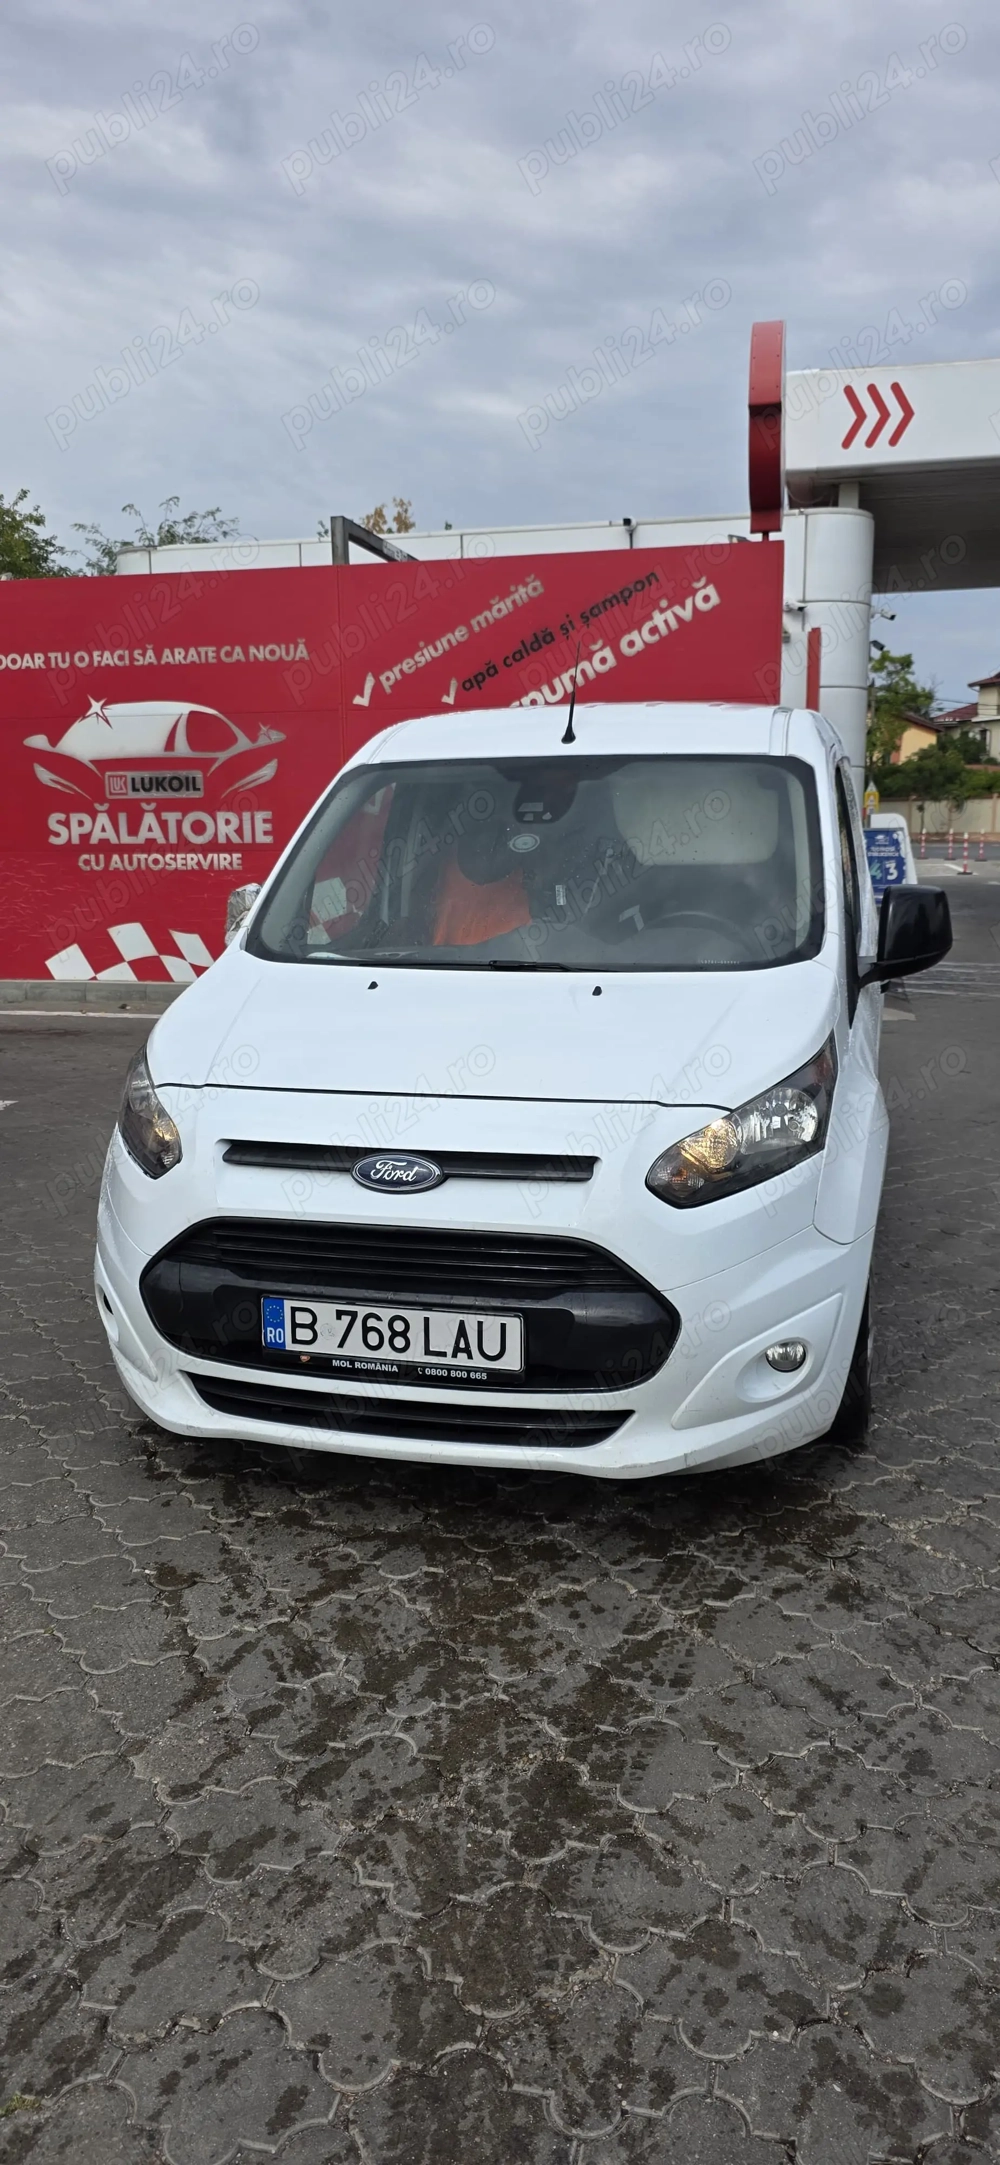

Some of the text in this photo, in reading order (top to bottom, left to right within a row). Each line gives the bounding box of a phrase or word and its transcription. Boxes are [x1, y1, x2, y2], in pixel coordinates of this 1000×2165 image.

[379, 574, 544, 694] presiune mărită
[462, 571, 659, 692] apă caldă și șampon
[509, 576, 720, 707] umă activă
[47, 652, 70, 669] TU
[74, 651, 90, 668] O
[93, 650, 129, 667] FACI
[134, 644, 157, 665] SĂ
[161, 646, 217, 665] ARATE
[220, 646, 245, 663] CA
[250, 639, 309, 663] NOUĂ
[131, 776, 201, 793] LUKOIL
[48, 803, 274, 845] SPĂLĂTORIE
[78, 853, 243, 871] CU AUTOSERVIRE
[886, 861, 898, 880] 3
[370, 1160, 418, 1182] Ford
[267, 1306, 507, 1361] RO B 768 LAU
[332, 1359, 487, 1380] MOL ROMÂNIA 0800 800 665
